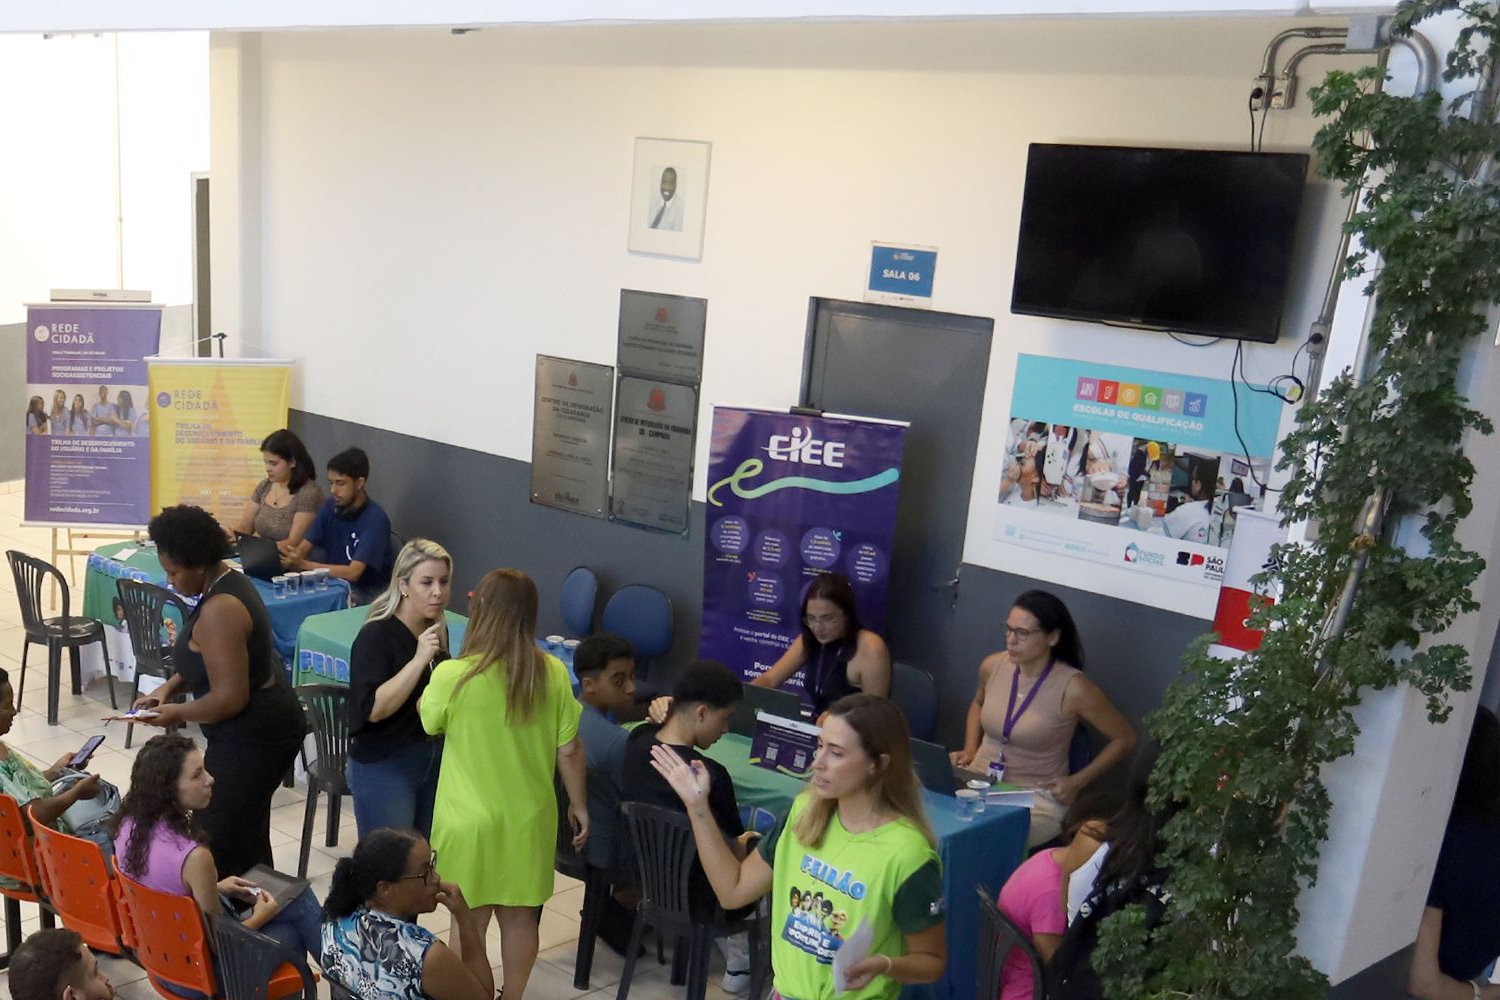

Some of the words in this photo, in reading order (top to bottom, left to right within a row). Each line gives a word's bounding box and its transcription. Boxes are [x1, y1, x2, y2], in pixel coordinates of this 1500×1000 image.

[882, 269, 906, 280] SALA
[908, 272, 920, 282] 06
[51, 323, 79, 333] REDE
[51, 332, 95, 344] CIDADÃ
[174, 390, 202, 400] REDE
[174, 400, 218, 410] CIDADÃ
[1073, 403, 1115, 417] ESCOLAS
[1117, 411, 1130, 419] DE
[1132, 413, 1203, 431] QUALIFICAÇÃO
[175, 430, 243, 438] DESENVOLVIMENTO
[49, 506, 100, 514] redecidada.org.br
[1138, 549, 1165, 560] FUNDO
[1138, 555, 1164, 567] SOCIAL
[1206, 556, 1224, 566] SÃO
[1205, 564, 1224, 573] PAUL
[733, 626, 750, 635] Acesse
[754, 629, 770, 639] portal
[758, 639, 780, 647] construir
[800, 853, 866, 901] FEIRÃO
